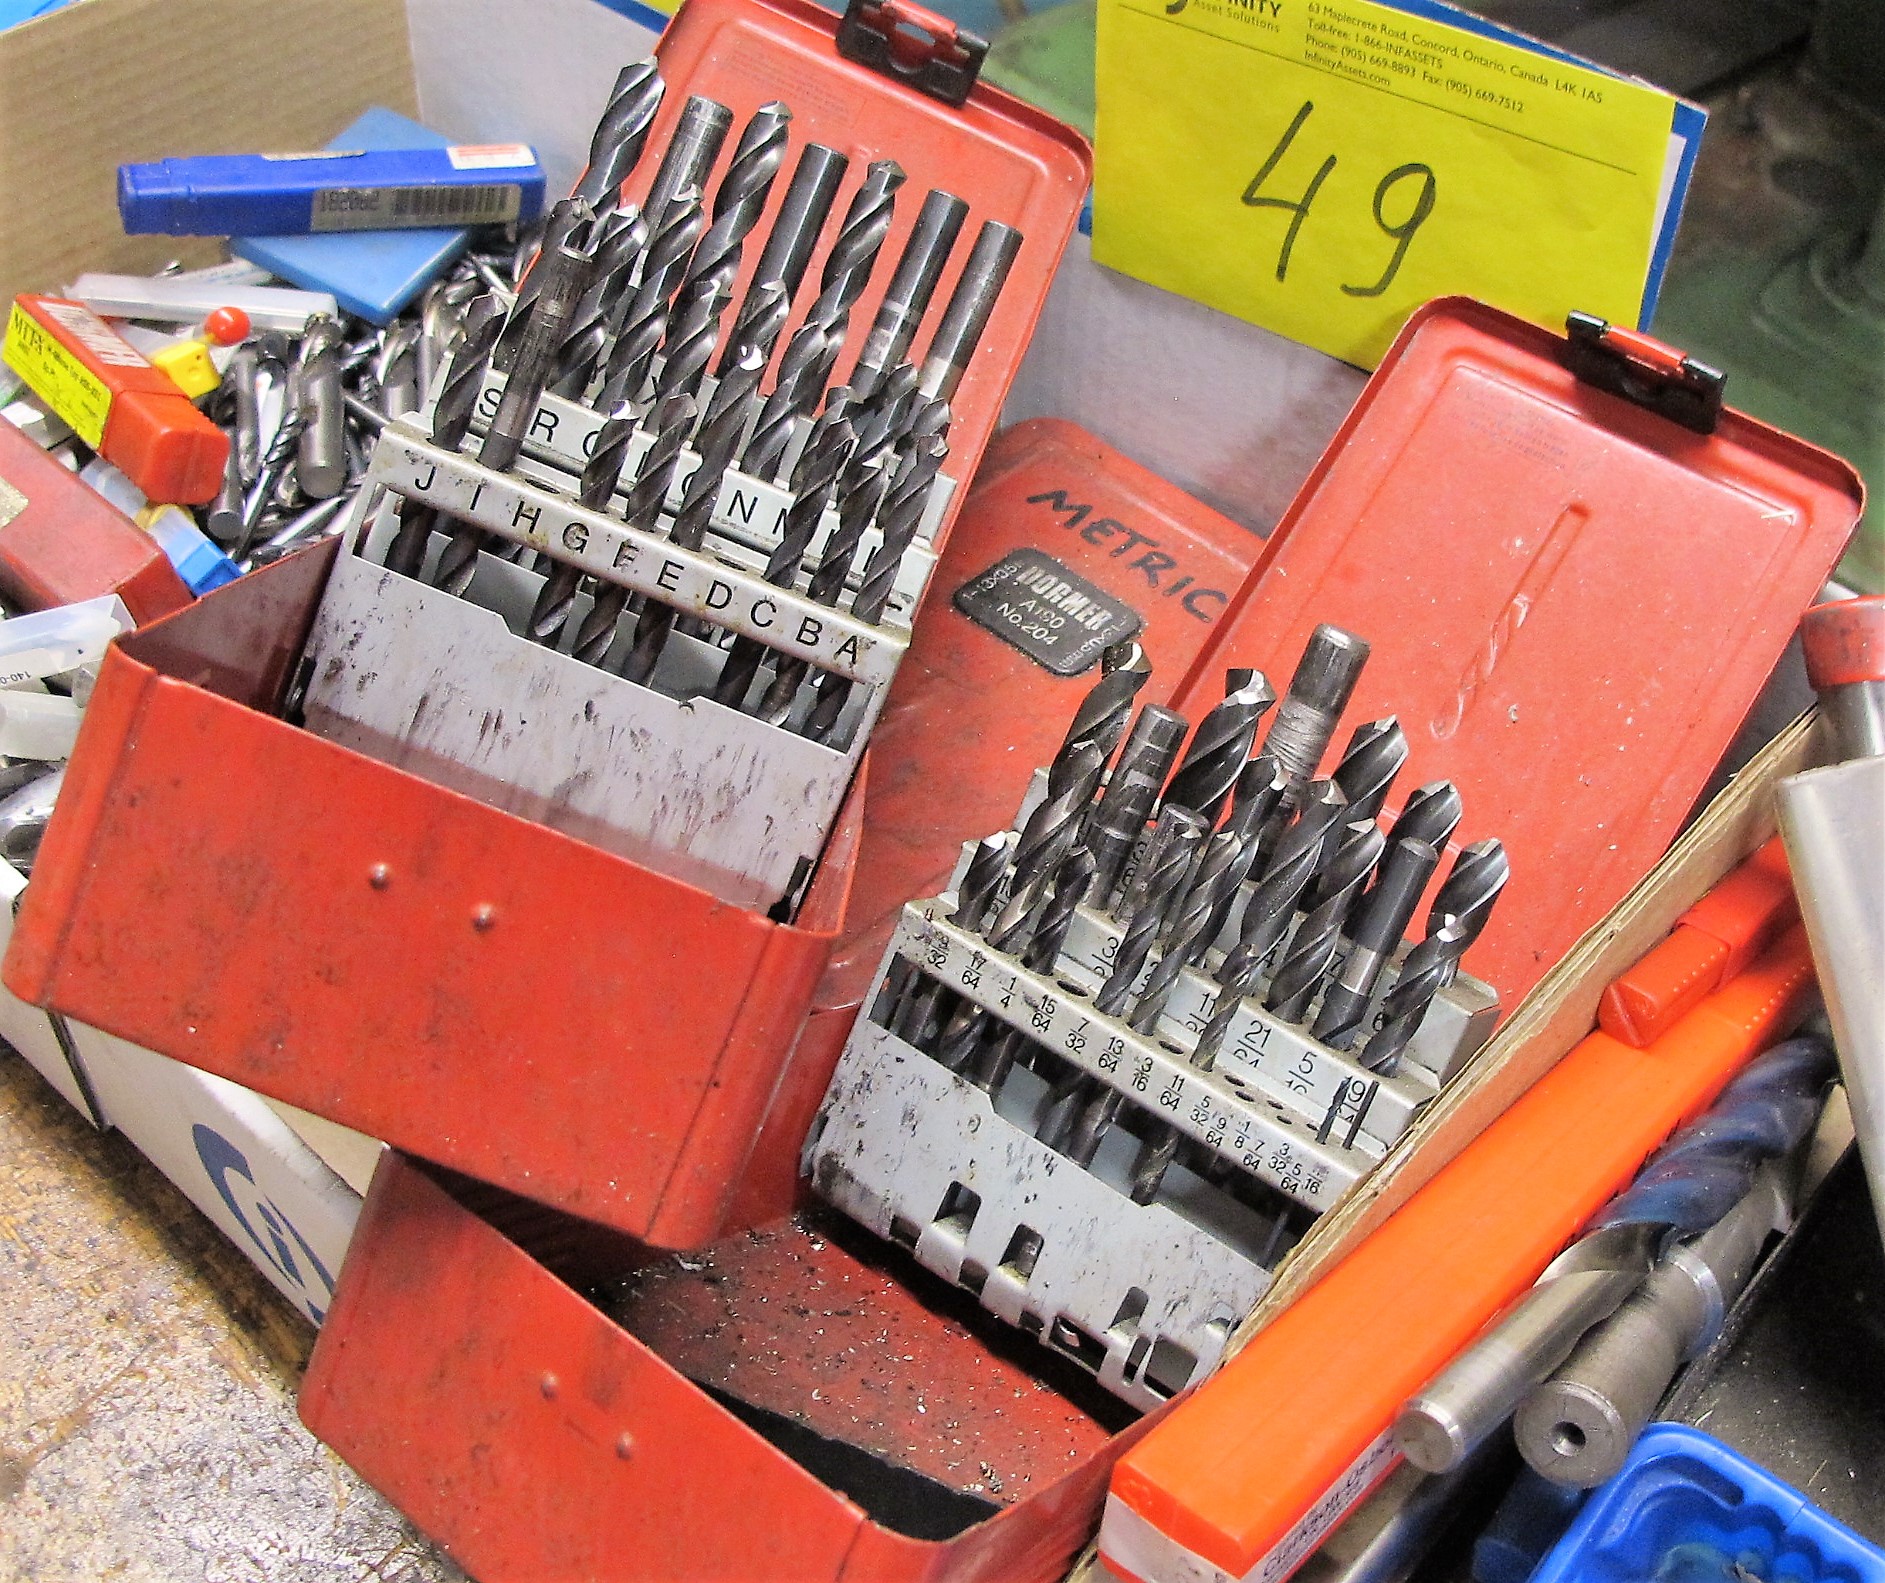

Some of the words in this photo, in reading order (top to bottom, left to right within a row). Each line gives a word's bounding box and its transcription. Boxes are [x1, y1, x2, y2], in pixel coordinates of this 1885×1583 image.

[1226, 6, 1280, 33] Solutions
[1308, 3, 1320, 15] 63
[1323, 5, 1378, 33] Maplecrete
[1412, 34, 1459, 60] Concord,
[1463, 50, 1507, 74] Ontario,
[1510, 65, 1549, 87] Canada
[1555, 79, 1577, 97] L4K
[1305, 51, 1390, 87] InfinityAssets.com
[1341, 48, 1366, 64] (905)
[1370, 56, 1416, 78] 669-8893
[1446, 79, 1472, 98] (905)
[1475, 89, 1524, 113] 669-7512
[1241, 100, 1436, 297] 49
[529, 407, 560, 443] R
[727, 489, 759, 524] N
[415, 466, 437, 491] J
[470, 484, 484, 511] I
[512, 500, 542, 534] H
[562, 522, 590, 554] G
[613, 541, 640, 569] F
[656, 559, 685, 592] E
[705, 579, 733, 610] D
[750, 599, 777, 628] C
[795, 616, 823, 647] B
[834, 635, 859, 665] A
[1027, 489, 1228, 624] METRIC
[927, 950, 946, 970] 32
[961, 970, 981, 990] 64
[1041, 994, 1058, 1015] 15
[1031, 1012, 1052, 1033] 64
[1077, 1016, 1091, 1033] 7
[1065, 1033, 1086, 1055] 32
[1244, 1019, 1273, 1049] 21
[1107, 1035, 1125, 1055] 13
[1098, 1053, 1118, 1074] 64
[1141, 1056, 1154, 1073] 3
[1298, 1050, 1318, 1075] 5
[1170, 1074, 1186, 1092] 11
[1159, 1090, 1182, 1112] 64
[1200, 1095, 1213, 1109] 5
[1190, 1108, 1209, 1127] 32
[1216, 1117, 1227, 1130] 9
[1205, 1130, 1224, 1149] 64
[1234, 1135, 1245, 1149] 8
[1254, 1139, 1266, 1152] 7
[1279, 1142, 1290, 1156] 3
[1242, 1153, 1261, 1171] 64
[1268, 1156, 1287, 1175] 32
[1292, 1163, 1303, 1176] 5
[1280, 1176, 1300, 1195] 64
